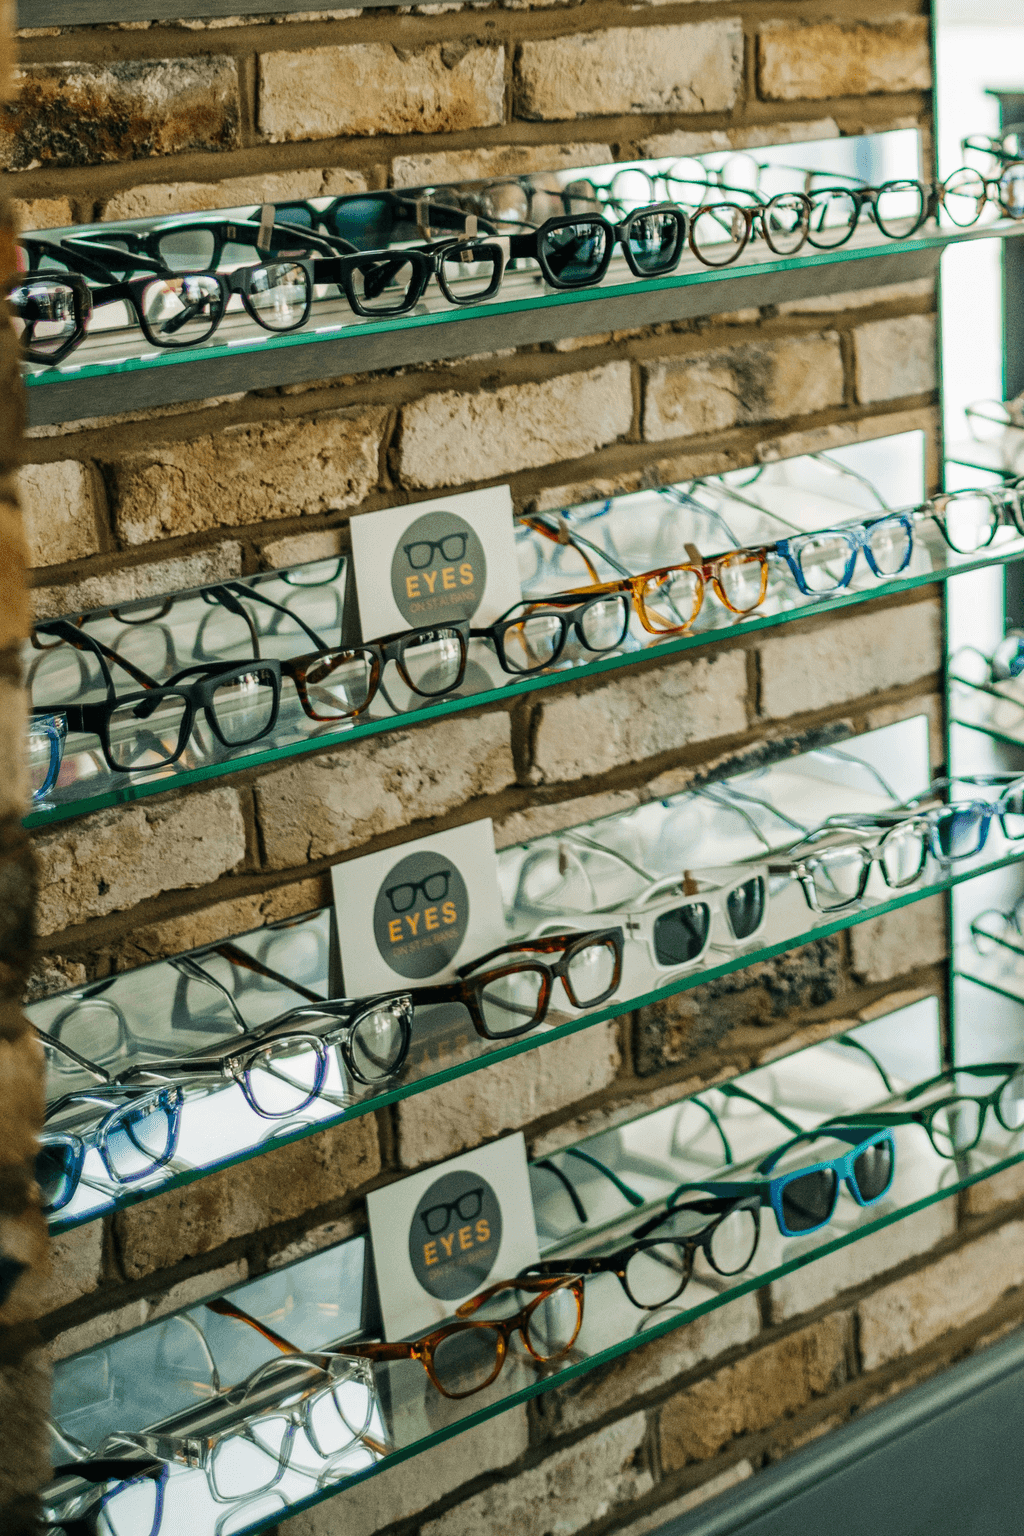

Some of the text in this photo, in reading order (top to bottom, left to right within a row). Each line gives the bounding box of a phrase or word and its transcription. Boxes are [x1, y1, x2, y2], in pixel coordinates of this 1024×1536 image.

[405, 563, 475, 598] EYES
[388, 901, 458, 943] EYES
[423, 1219, 491, 1266] EYES
